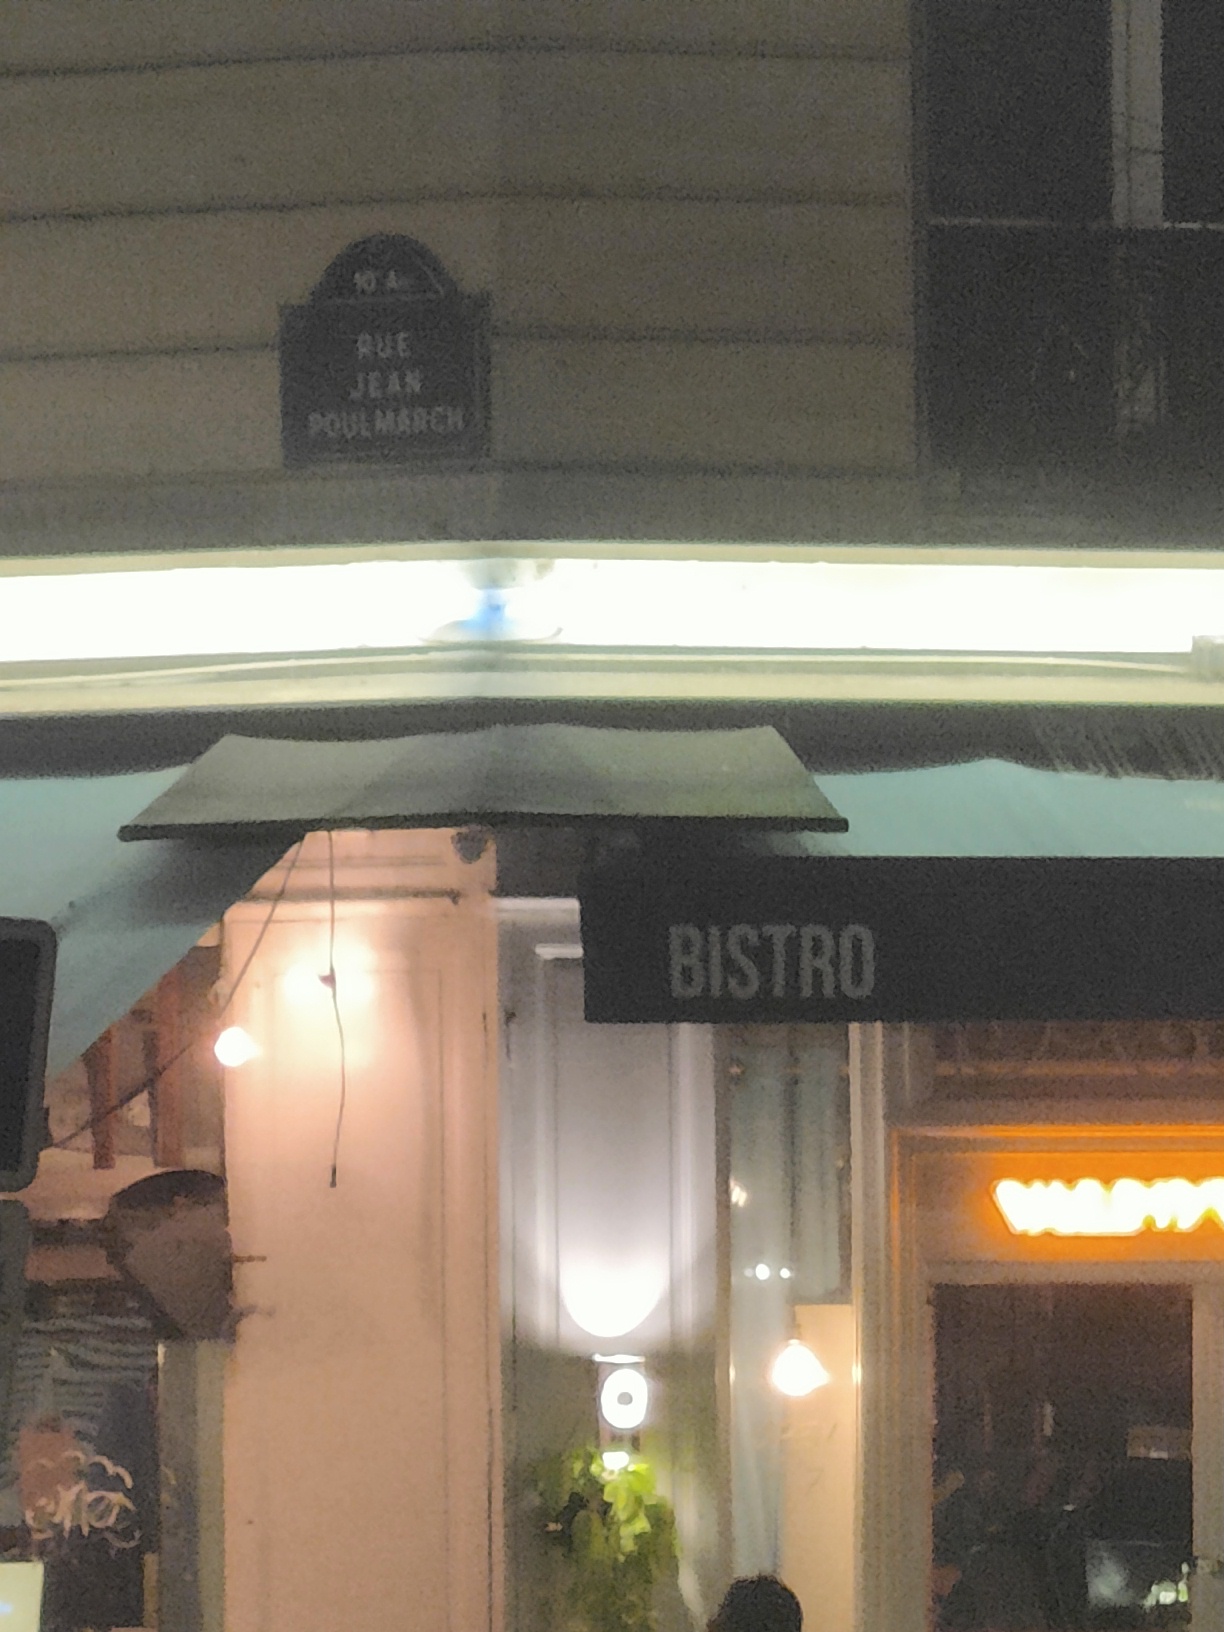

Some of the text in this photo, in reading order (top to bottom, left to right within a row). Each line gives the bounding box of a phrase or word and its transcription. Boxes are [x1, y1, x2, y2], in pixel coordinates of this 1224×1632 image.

[356, 331, 411, 360] RUE
[349, 369, 423, 400] JEAN
[308, 405, 466, 439] POULMARCH
[668, 923, 876, 1000] BISTRO
